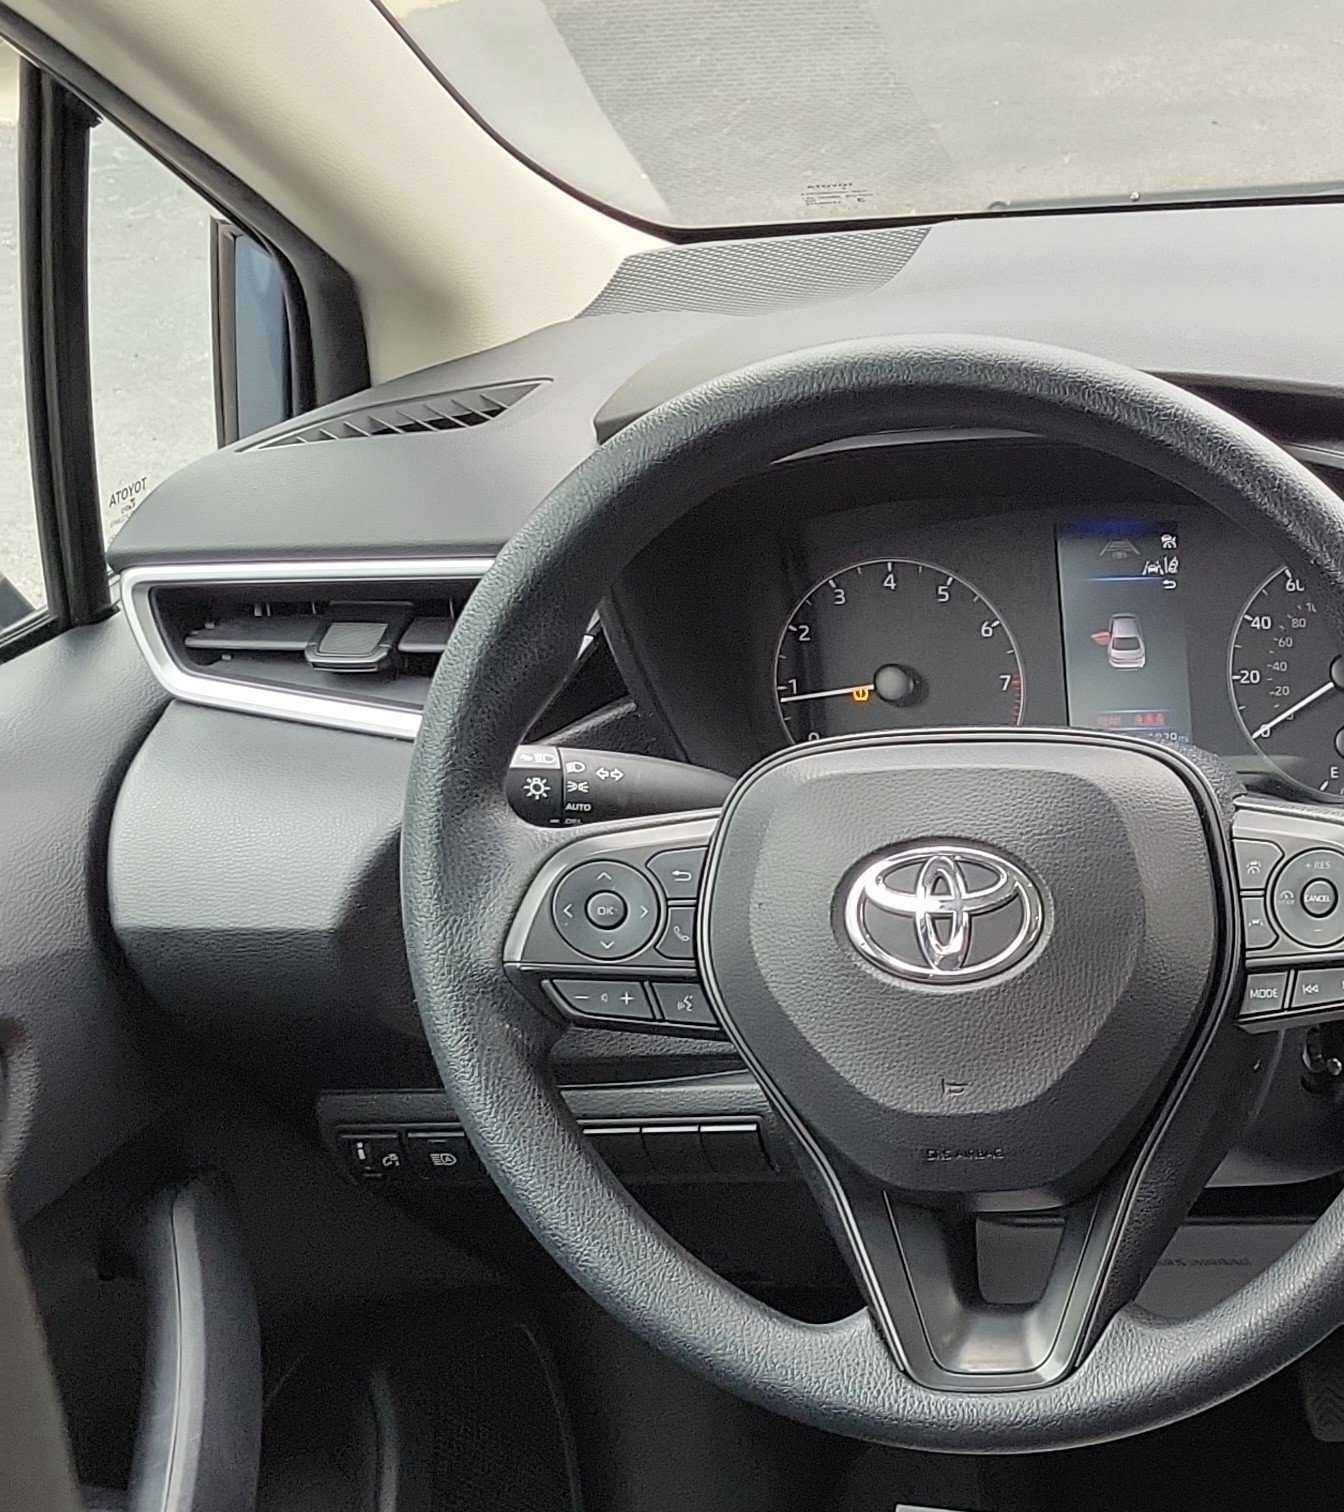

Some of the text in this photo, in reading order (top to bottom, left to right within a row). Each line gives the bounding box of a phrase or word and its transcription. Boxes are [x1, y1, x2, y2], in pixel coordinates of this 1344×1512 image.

[883, 574, 897, 590] 4
[834, 589, 846, 605] 3
[937, 586, 950, 602] 5
[981, 621, 994, 637] 6
[1250, 615, 1272, 630] 40
[1291, 617, 1307, 629] 80
[798, 625, 811, 642] 2
[1278, 636, 1293, 648] 60
[1272, 661, 1288, 672] 40
[999, 674, 1012, 691] 7
[1239, 670, 1260, 684] 20
[788, 679, 797, 694] 1
[1275, 685, 1290, 696] 20
[1331, 766, 1339, 779] E
[565, 803, 592, 812] AUTO
[1314, 860, 1331, 870] RES
[1304, 894, 1331, 903] CANCEL
[597, 906, 614, 916] OK
[1250, 988, 1279, 999] MODE
